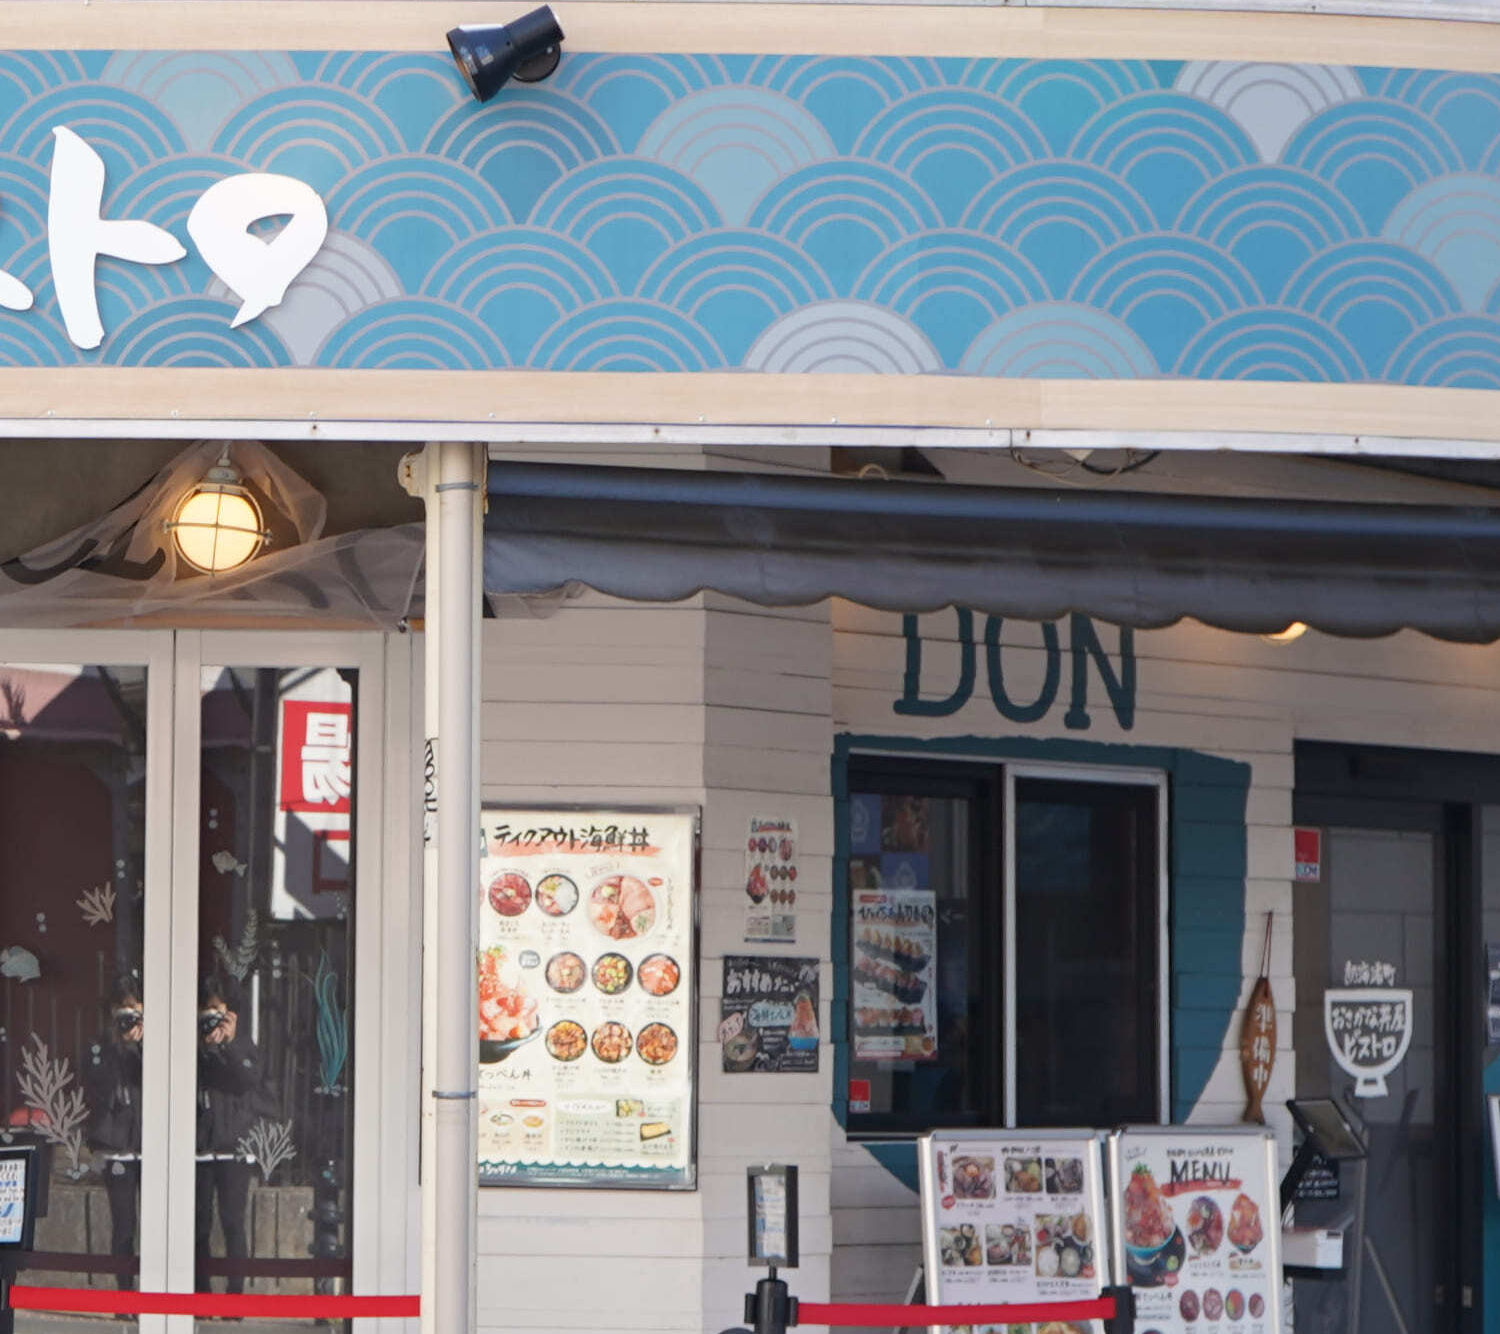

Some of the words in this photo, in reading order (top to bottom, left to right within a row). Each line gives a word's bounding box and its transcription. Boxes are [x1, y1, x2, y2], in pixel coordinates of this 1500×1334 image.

[1343, 1029, 1396, 1061] ビストロ
[1170, 1160, 1230, 1195] MENU
